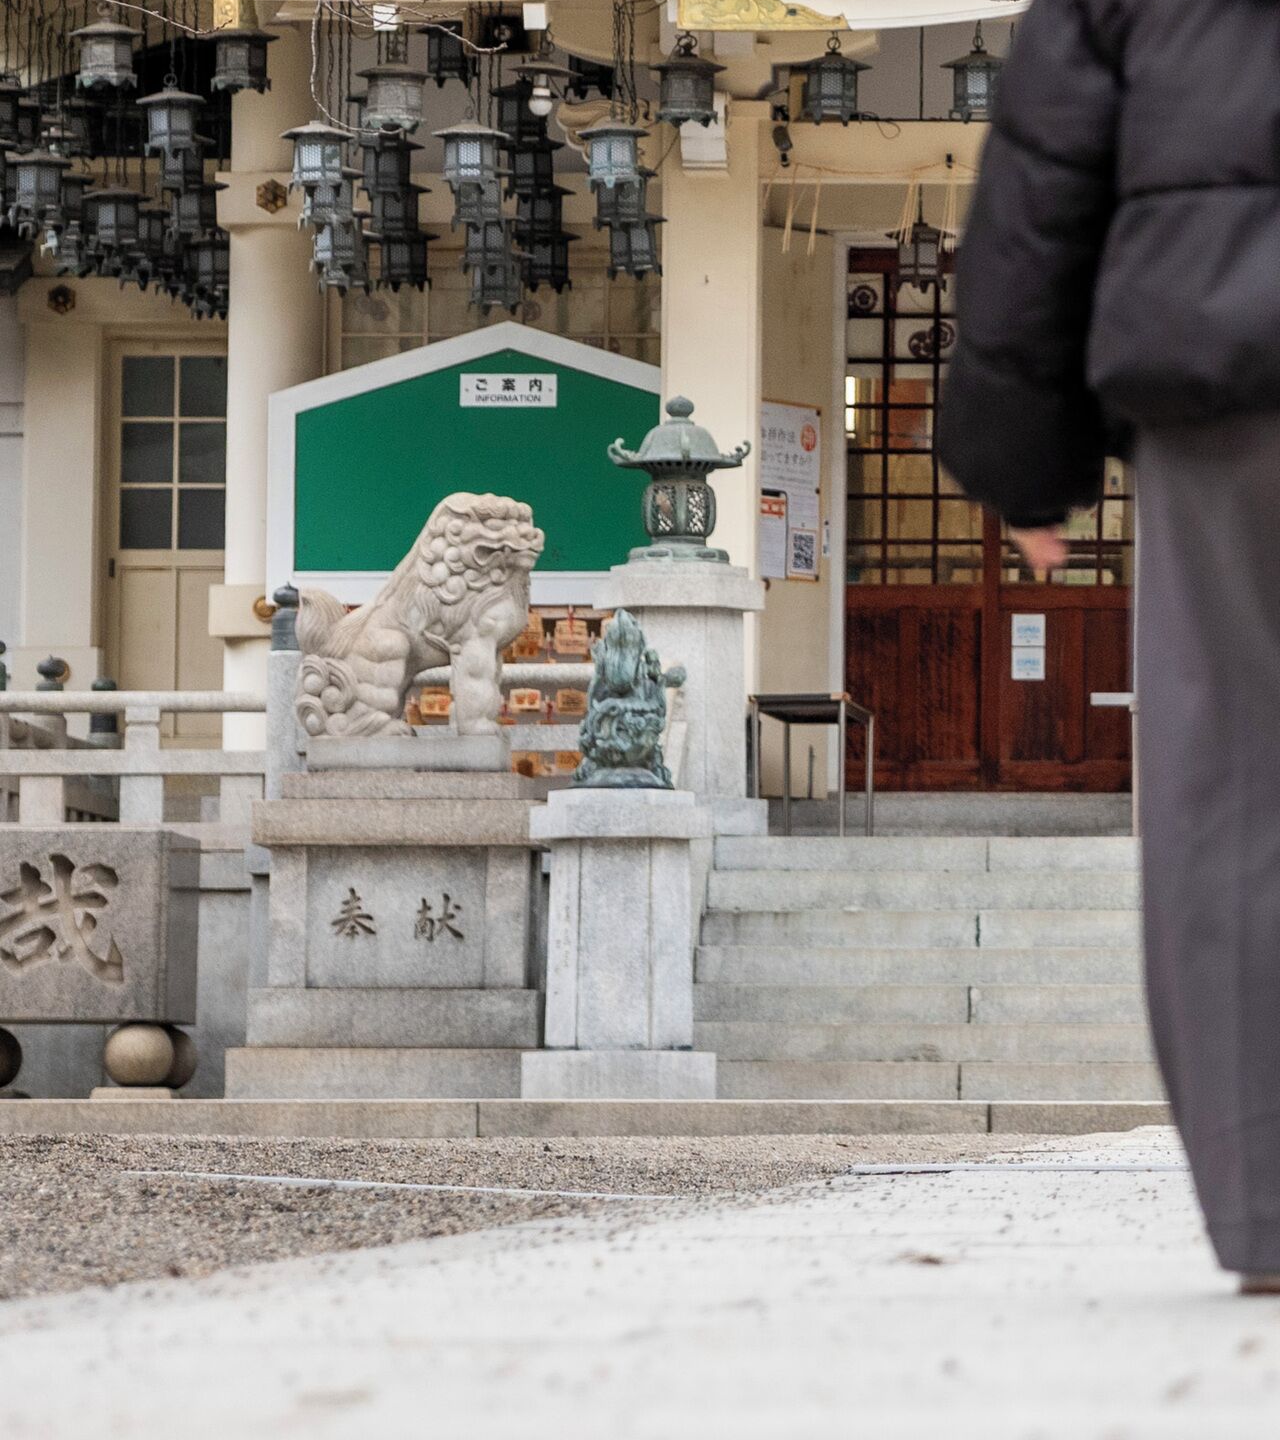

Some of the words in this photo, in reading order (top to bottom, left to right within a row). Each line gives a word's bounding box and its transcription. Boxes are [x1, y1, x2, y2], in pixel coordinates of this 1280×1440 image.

[475, 377, 543, 392] ご案内
[475, 394, 542, 402] INFORMATION
[331, 887, 464, 942] 奉献
